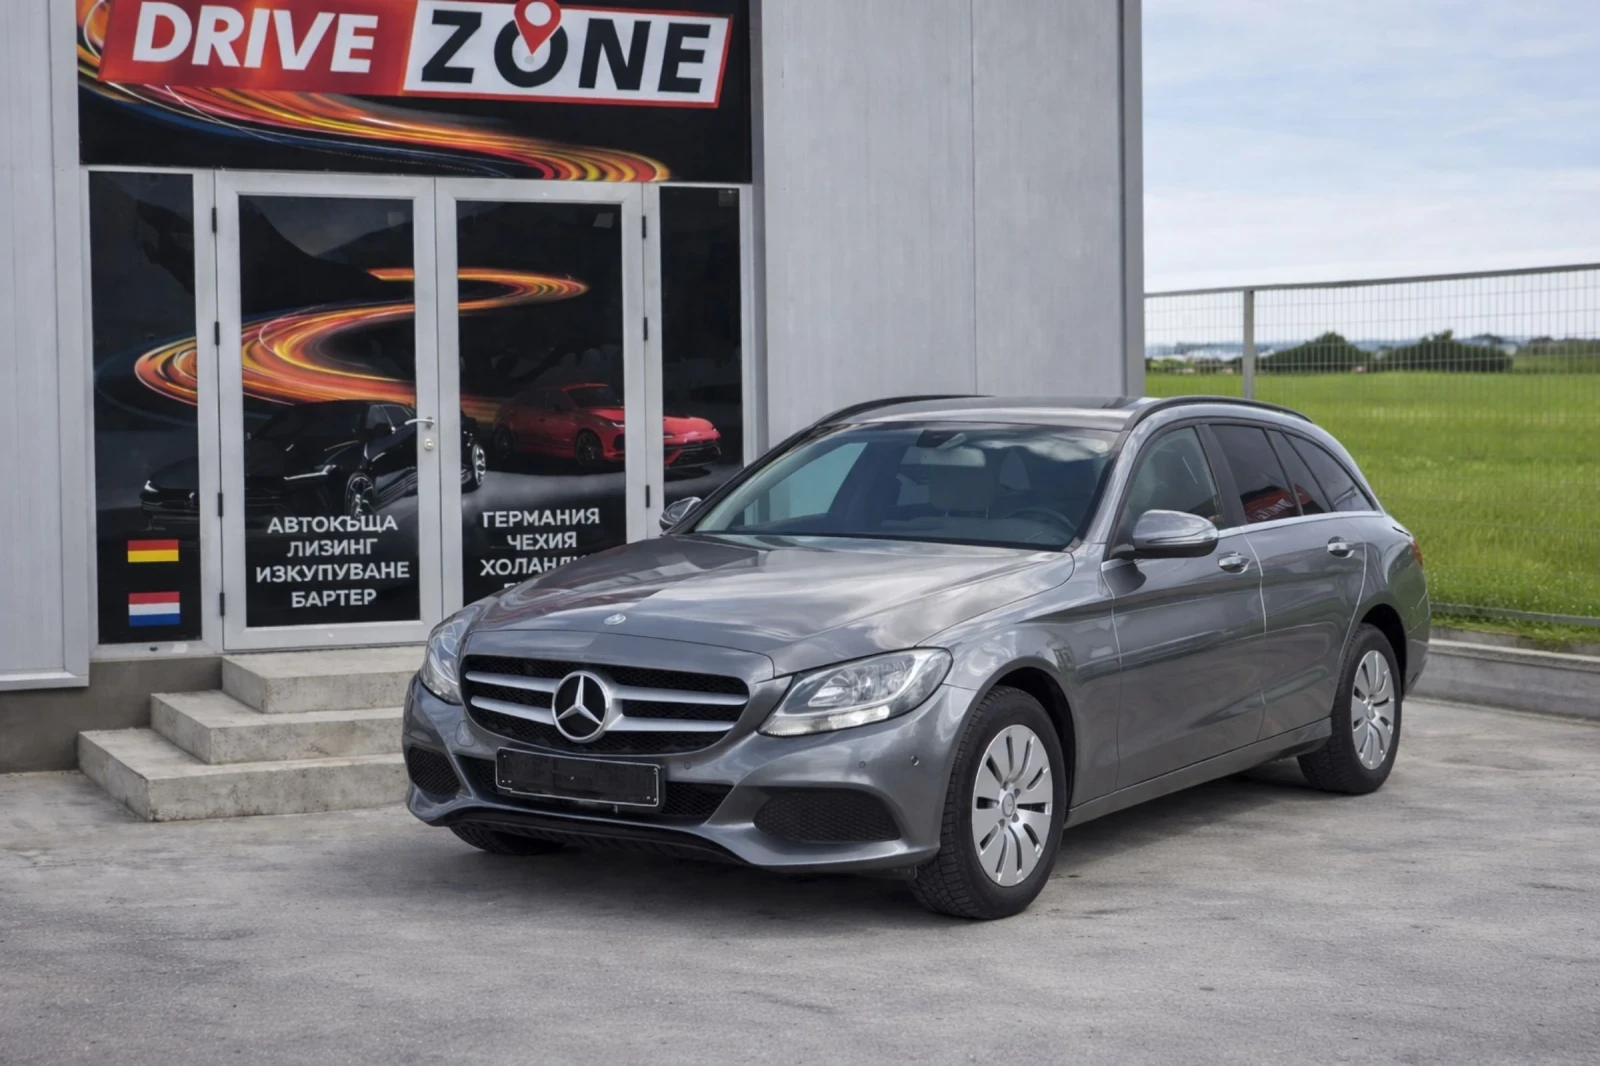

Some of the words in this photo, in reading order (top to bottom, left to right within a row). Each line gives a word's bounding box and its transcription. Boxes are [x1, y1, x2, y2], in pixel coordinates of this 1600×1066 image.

[132, 1, 379, 73] DRIVE
[421, 9, 711, 93] ZONE
[267, 515, 398, 533] АВТОКЪЩА
[482, 507, 600, 528] ГЕРМАНИЯ
[287, 538, 378, 557] ЛИЗИНГ
[507, 531, 577, 551] ЧЕХИЯ
[256, 561, 410, 583] ИЗКУПУВАНЕ
[291, 588, 377, 608] БАРТЕР
